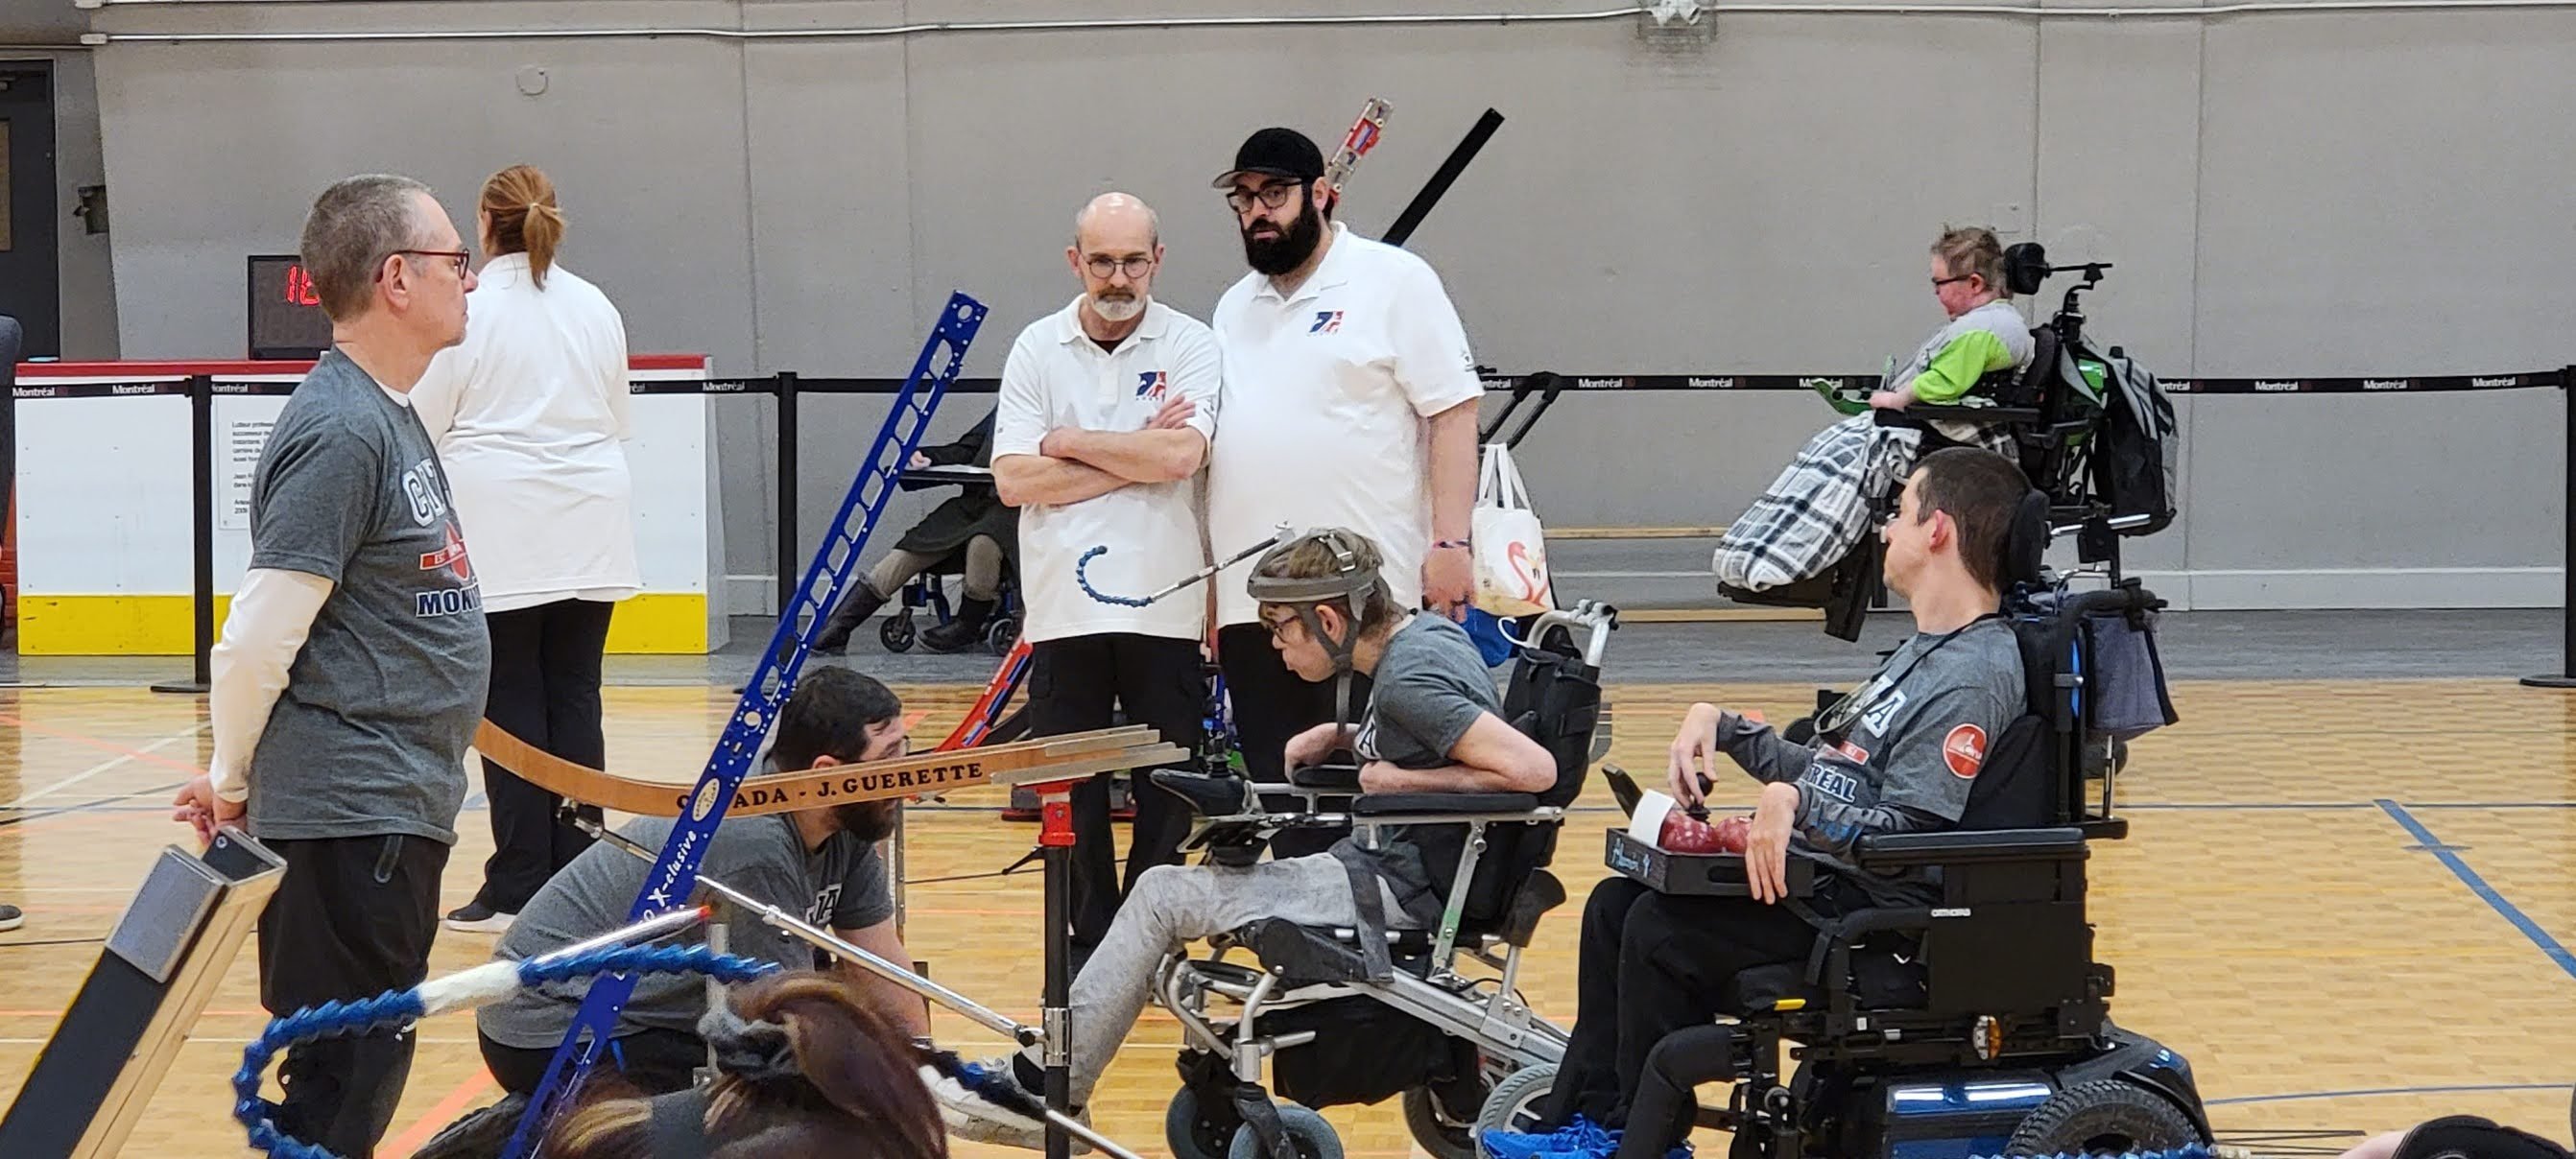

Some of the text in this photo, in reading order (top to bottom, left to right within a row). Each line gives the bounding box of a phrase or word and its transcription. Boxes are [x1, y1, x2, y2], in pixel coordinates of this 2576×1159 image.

[703, 382, 745, 391] Montréal
[1578, 378, 1623, 389] Montréal
[1689, 378, 1733, 389] Montréal
[2255, 380, 2299, 391] Montréal
[2363, 379, 2407, 390] Montréal
[2472, 377, 2516, 388] Montréal
[12, 387, 55, 397] Montréal
[112, 385, 155, 394] Montréal
[677, 787, 789, 810] CADA
